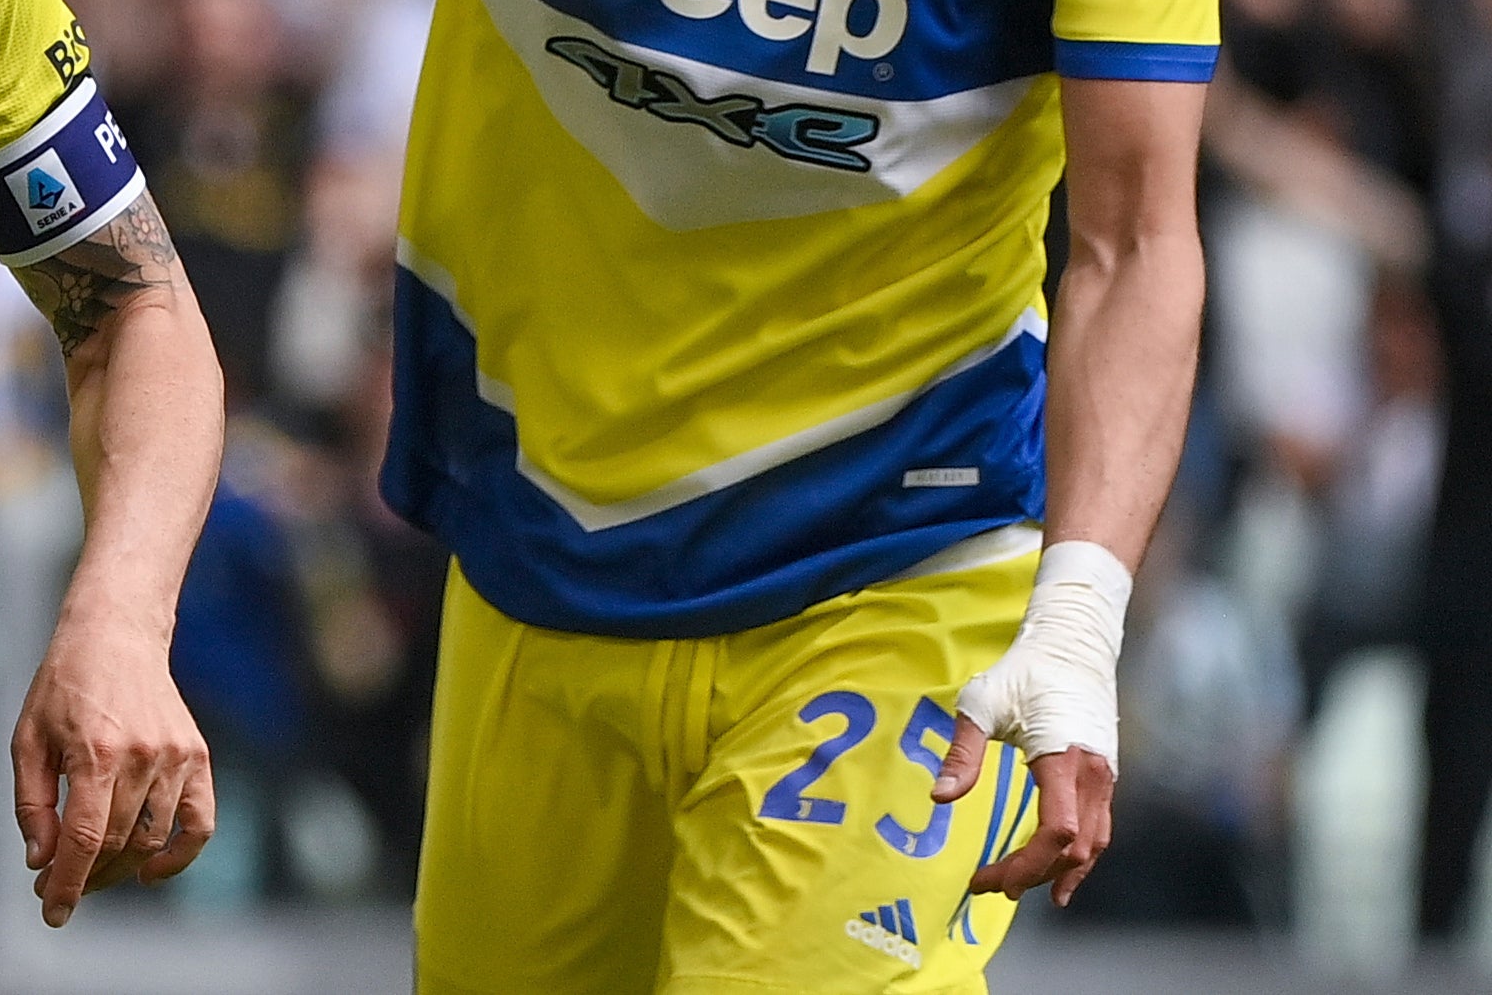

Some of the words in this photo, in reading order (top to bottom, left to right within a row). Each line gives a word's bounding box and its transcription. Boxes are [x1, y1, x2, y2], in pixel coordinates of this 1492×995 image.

[36, 206, 68, 229] SERIE
[68, 201, 77, 212] A
[759, 688, 956, 859] 25
